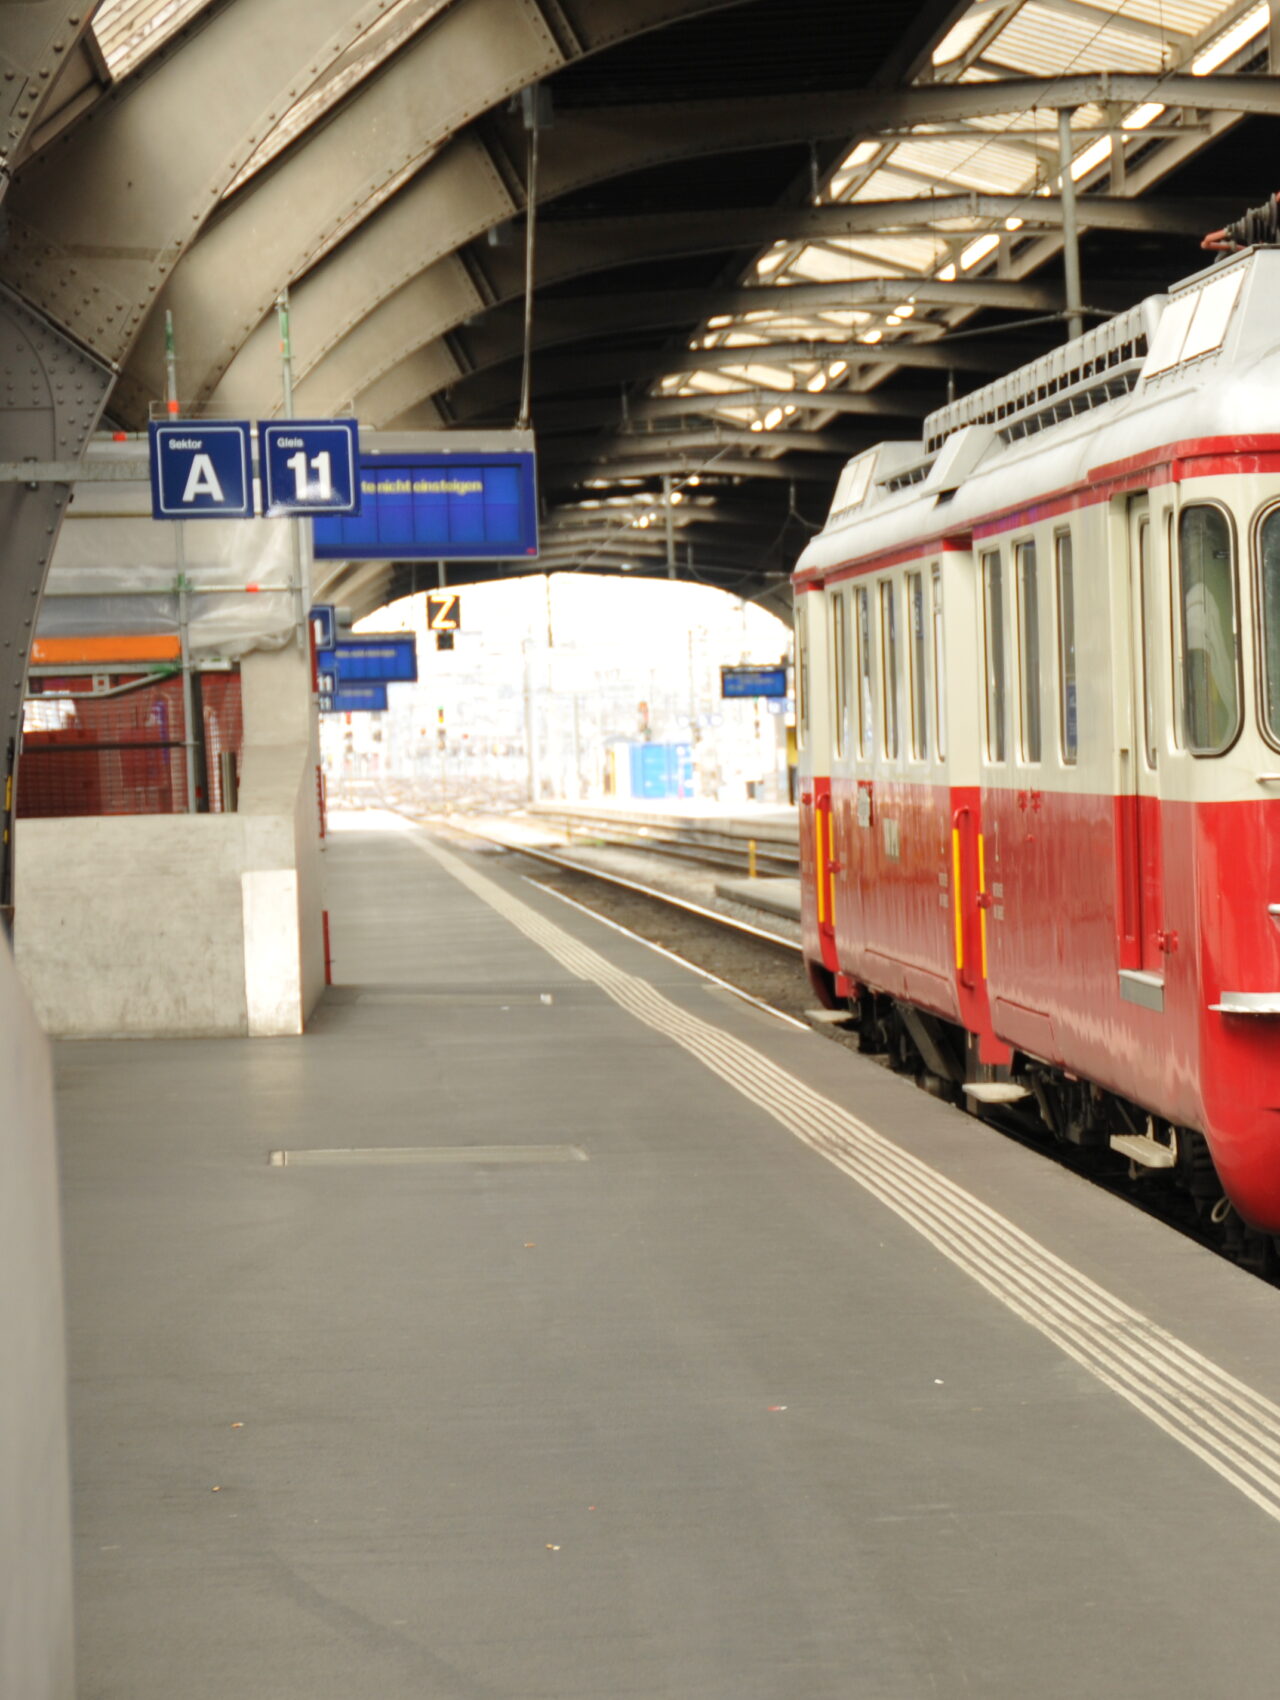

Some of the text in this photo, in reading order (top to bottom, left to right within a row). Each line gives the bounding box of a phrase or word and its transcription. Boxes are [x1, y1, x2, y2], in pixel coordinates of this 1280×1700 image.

[169, 439, 202, 449] Sektor
[277, 437, 304, 448] Gleis
[182, 453, 225, 502] A
[286, 451, 331, 500] 11
[377, 479, 411, 493] nicht
[413, 478, 483, 496] einsteigen
[430, 595, 456, 629] Z
